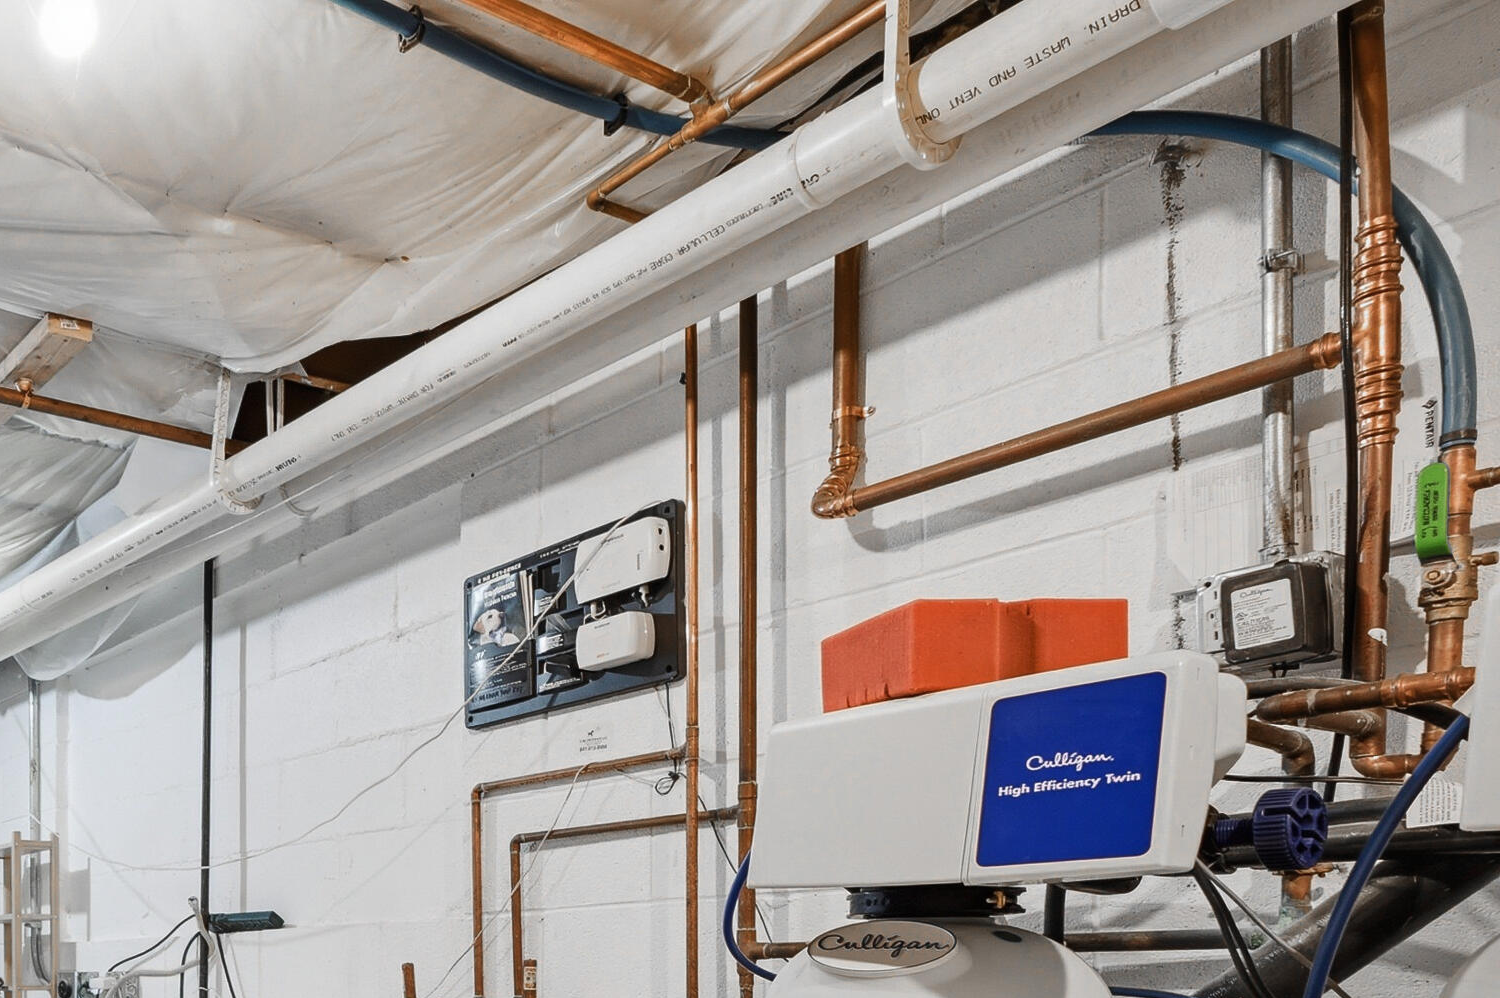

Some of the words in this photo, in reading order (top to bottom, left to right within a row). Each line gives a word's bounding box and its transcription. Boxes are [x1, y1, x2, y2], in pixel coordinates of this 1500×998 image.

[1025, 36, 1071, 69] WASTE
[988, 66, 1018, 88] AND
[948, 86, 982, 111] VENT
[915, 107, 941, 125] ONL
[678, 224, 726, 255] CELLULAR
[1425, 409, 1435, 449] PENTAIR
[998, 784, 1030, 798] High
[1033, 777, 1102, 793] Efficiency
[1105, 771, 1141, 784] Twin
[818, 933, 950, 958] Culligan
